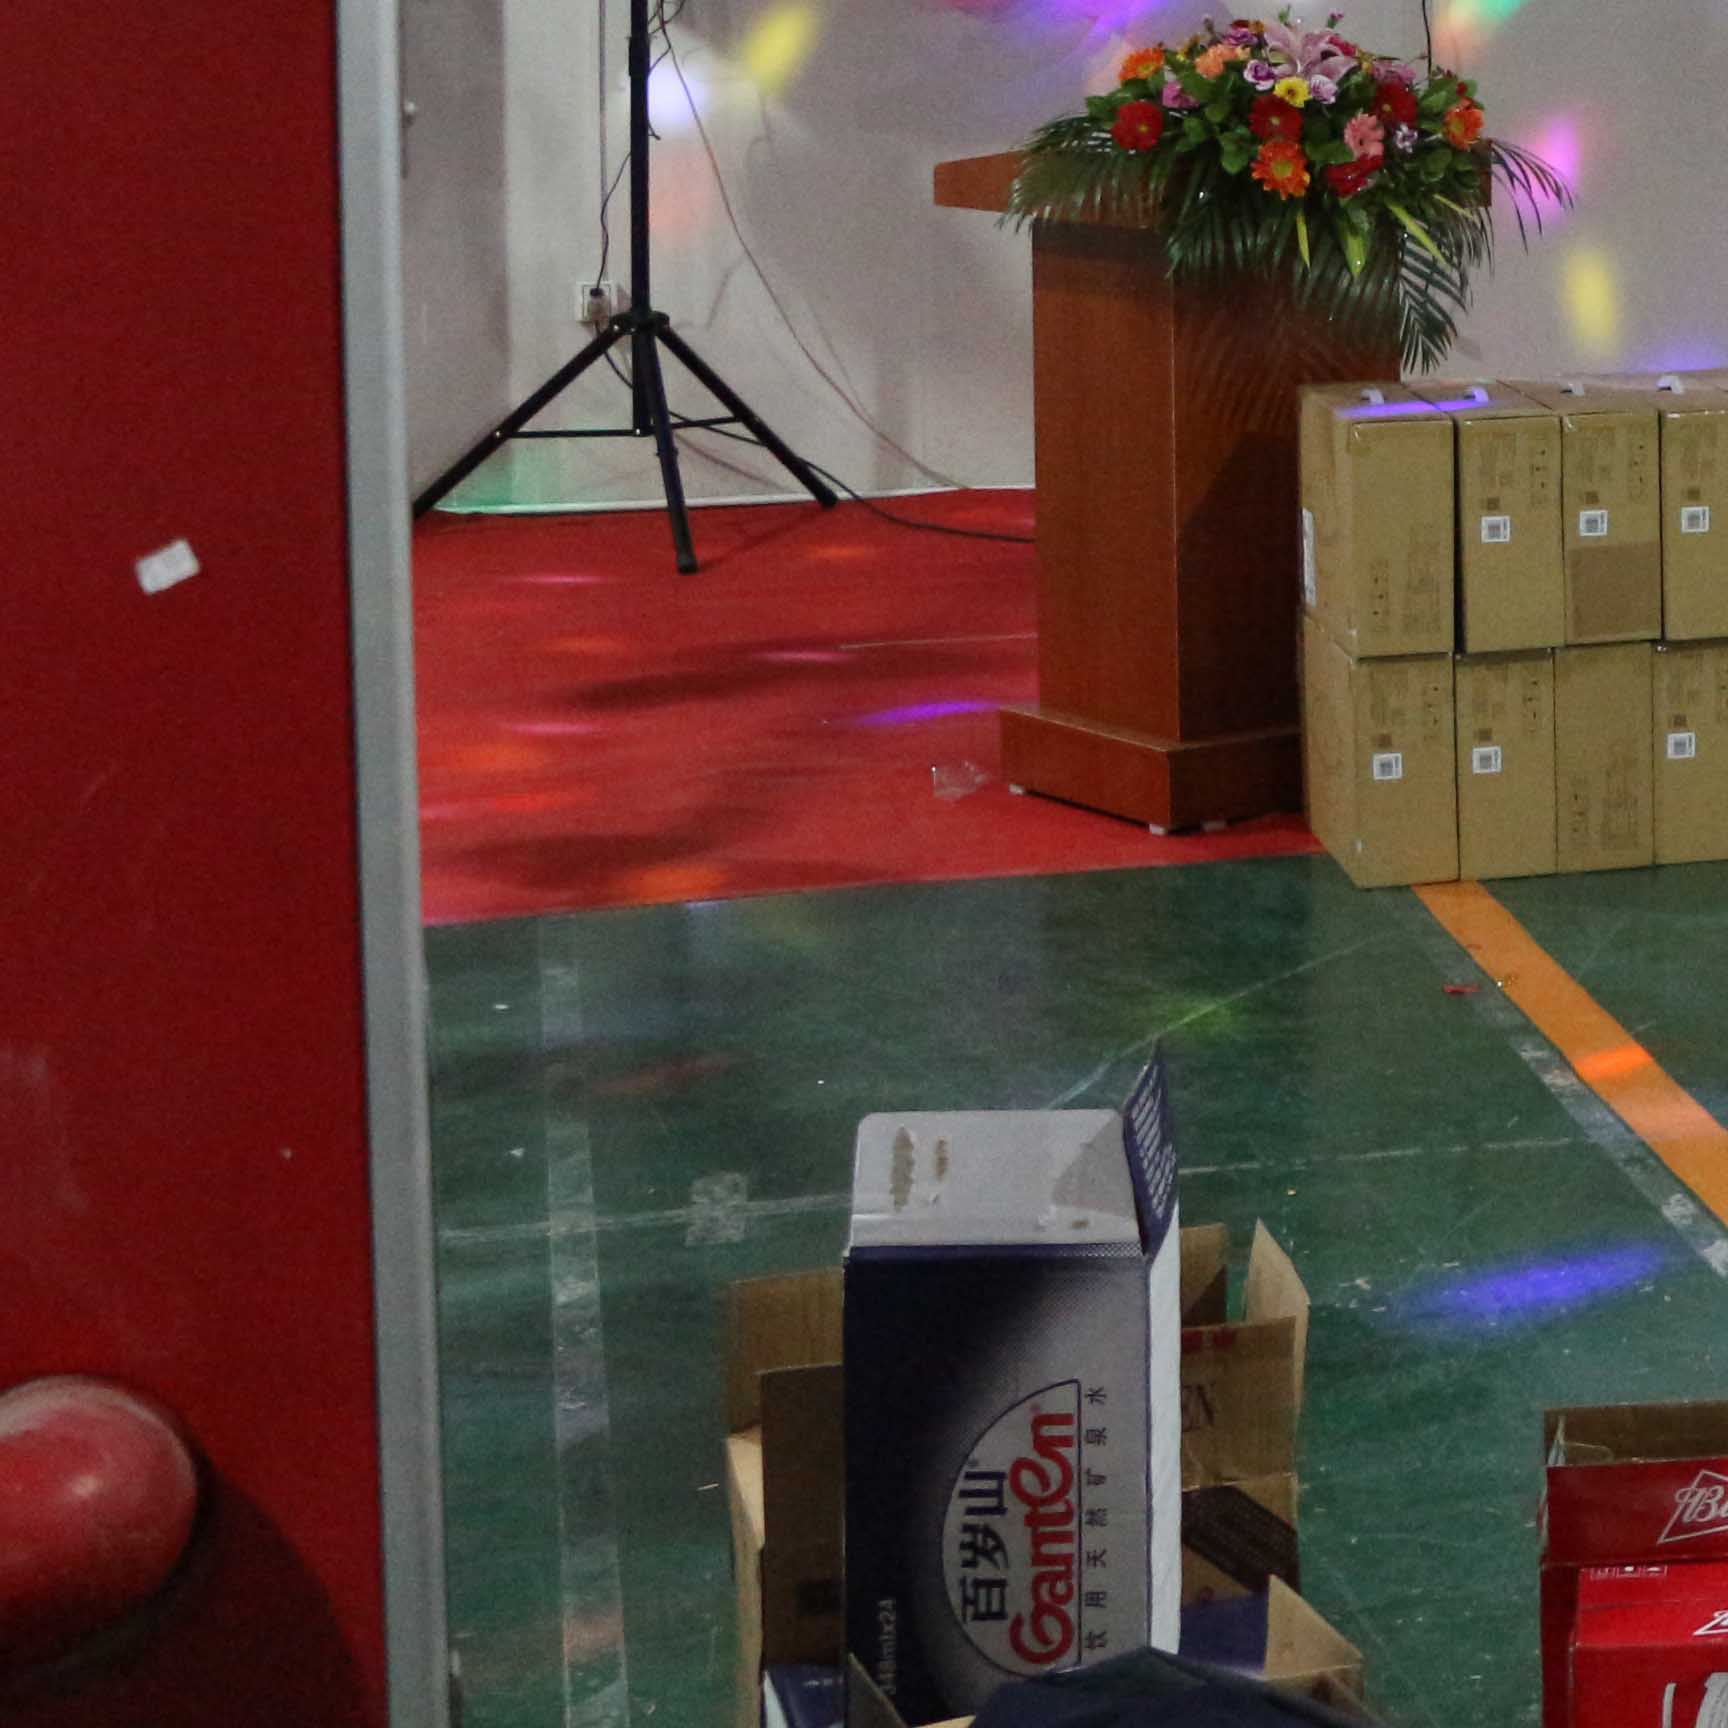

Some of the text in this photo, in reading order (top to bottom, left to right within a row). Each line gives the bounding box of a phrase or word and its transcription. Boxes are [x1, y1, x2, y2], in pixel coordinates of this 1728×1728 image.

[957, 1468, 1009, 1627] 百岁山
[1083, 1385, 1110, 1652] 饮用天然矿泉水
